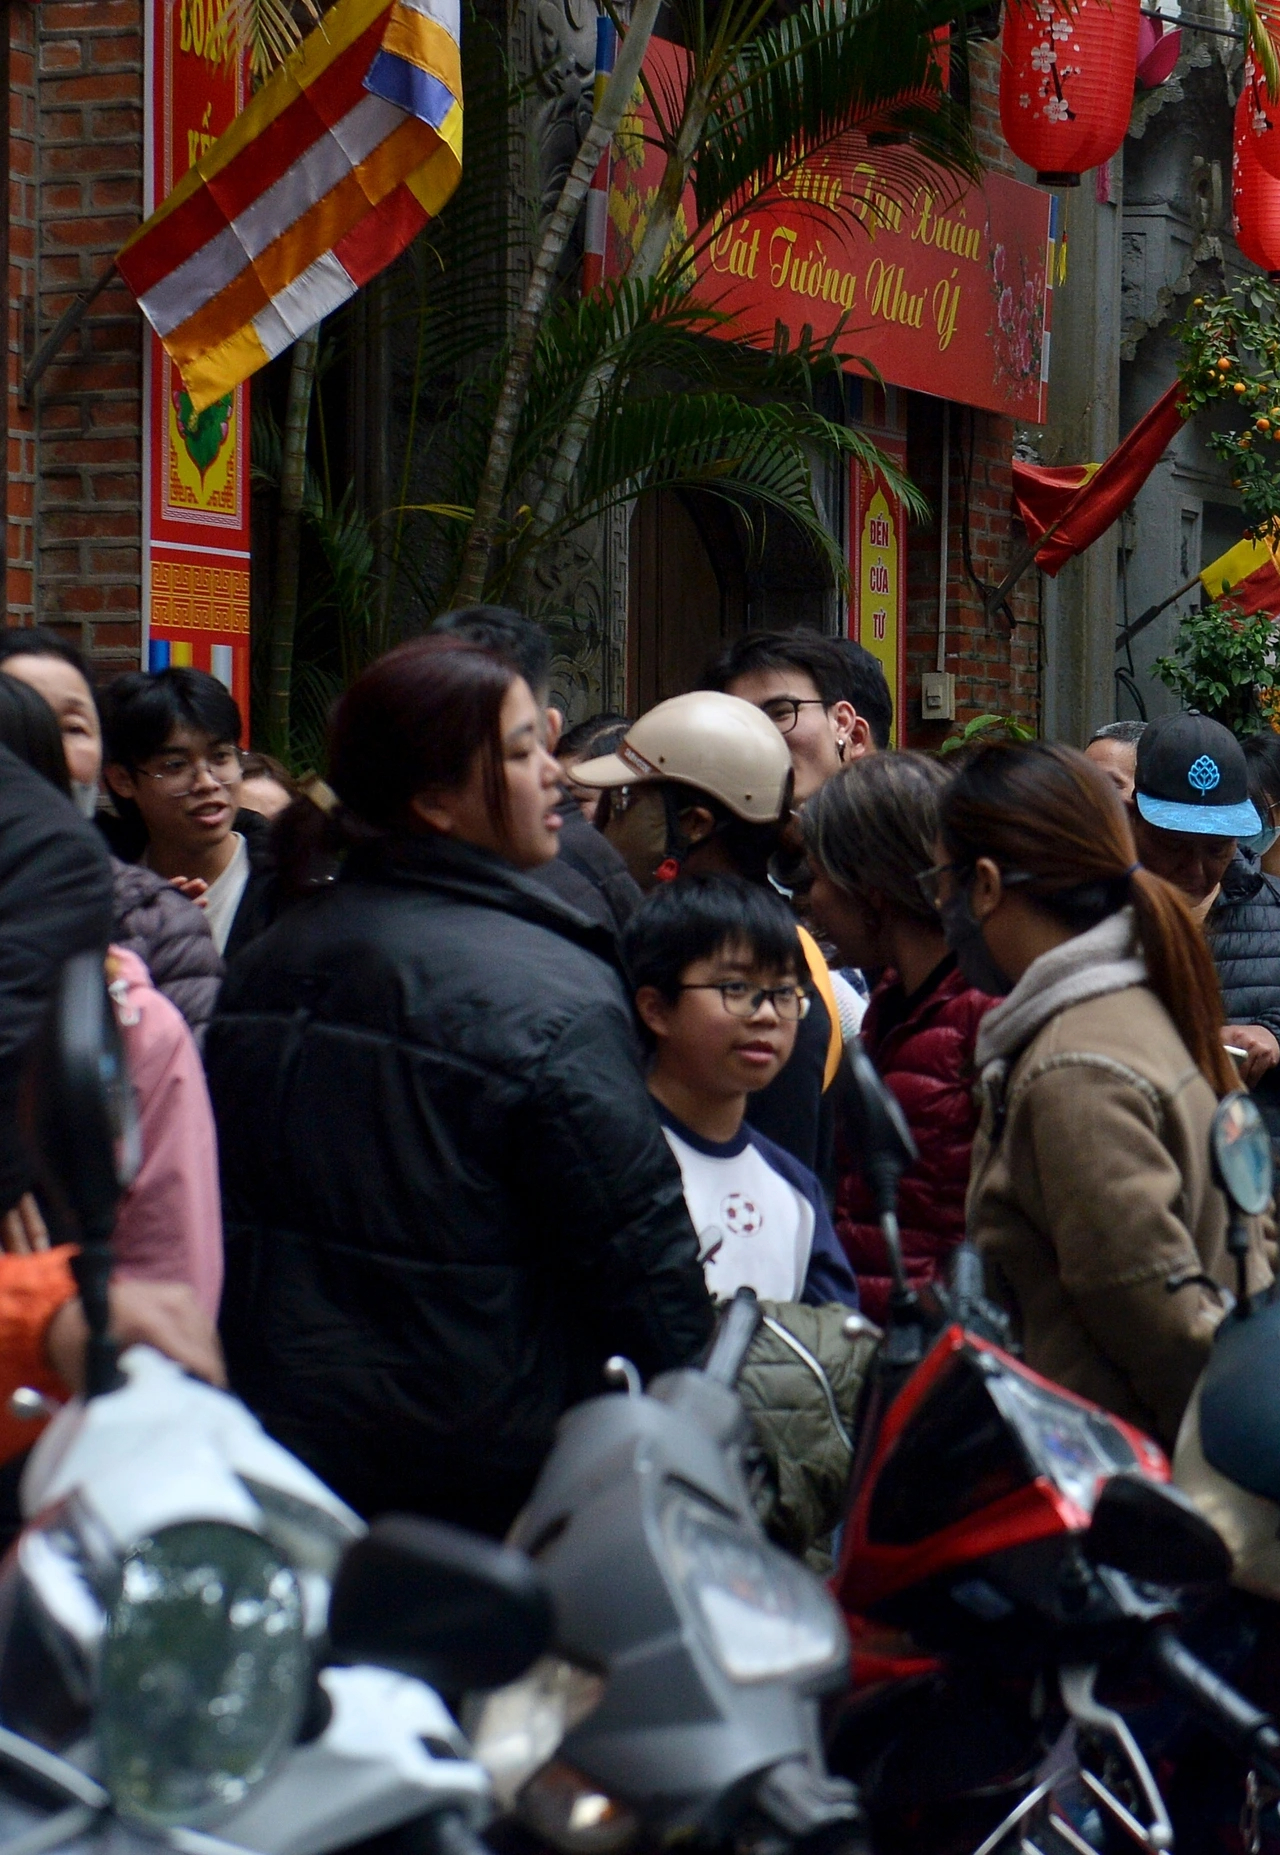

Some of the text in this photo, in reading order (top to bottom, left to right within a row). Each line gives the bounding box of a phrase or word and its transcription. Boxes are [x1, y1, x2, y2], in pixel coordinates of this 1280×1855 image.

[911, 185, 981, 262] Xuân
[709, 208, 962, 352] Cát Tường Như Ý
[869, 510, 890, 548] ĐẾN
[869, 557, 889, 594] CỬA
[872, 608, 887, 641] TỪ
